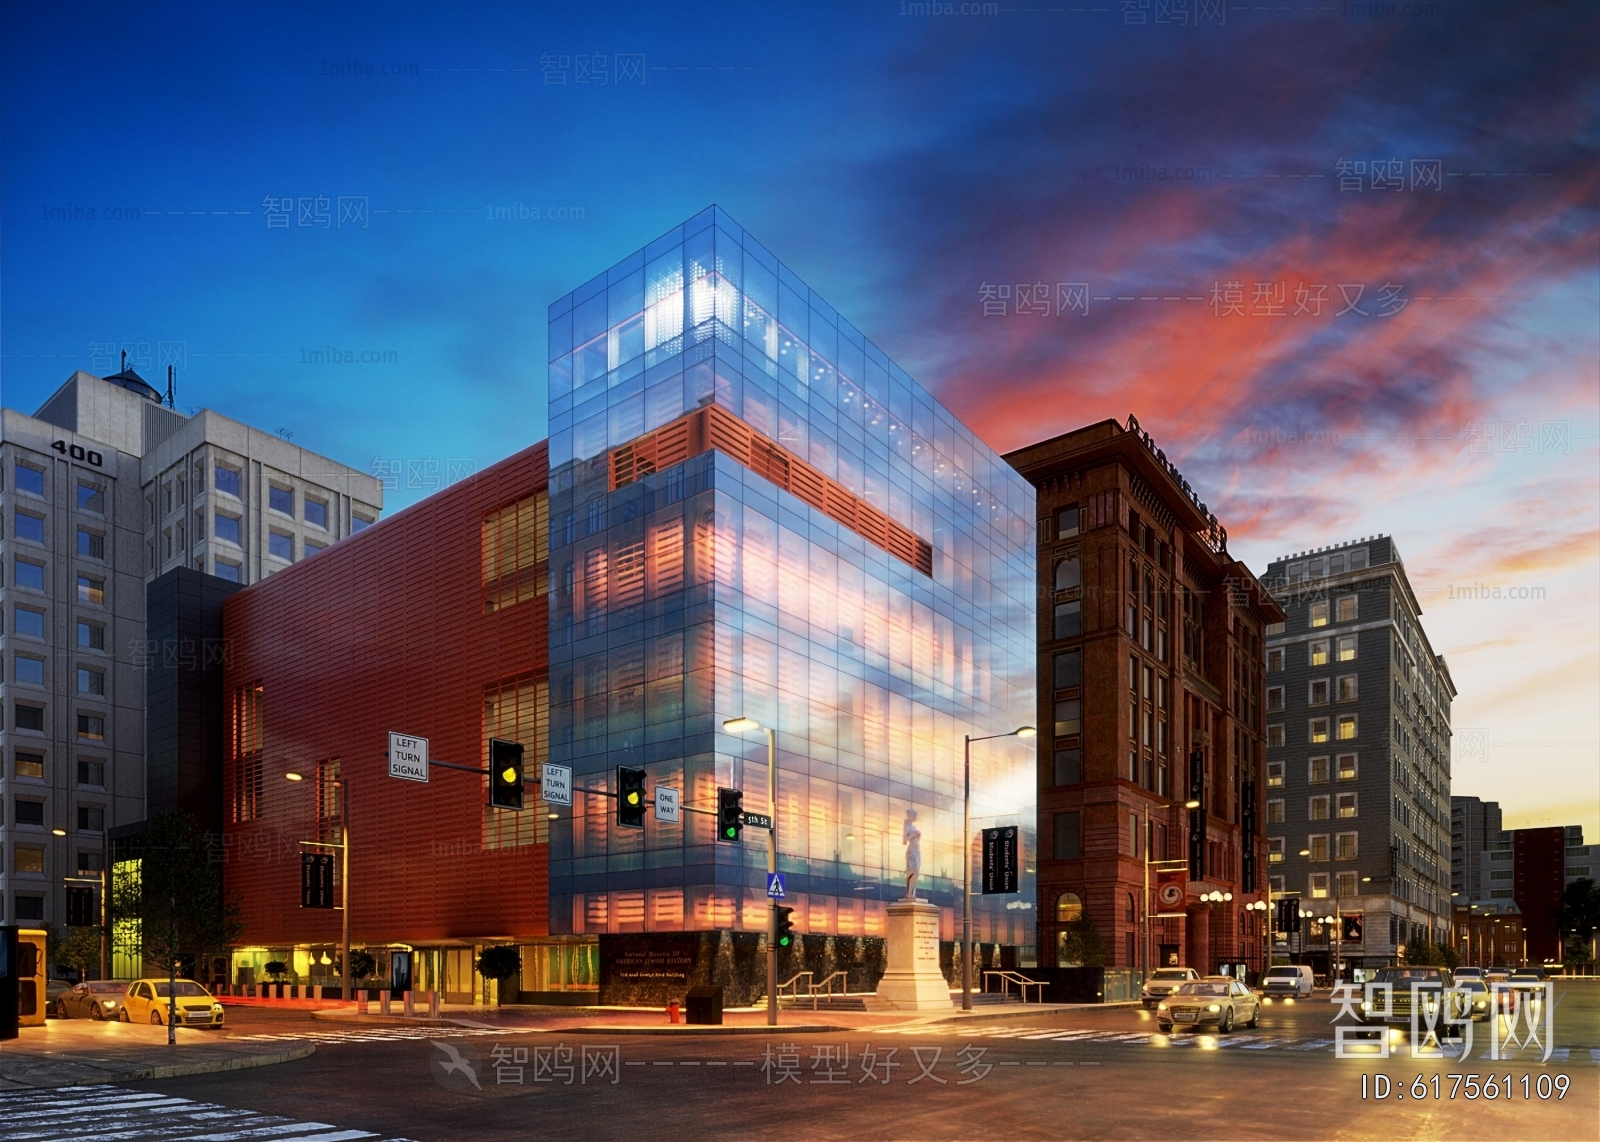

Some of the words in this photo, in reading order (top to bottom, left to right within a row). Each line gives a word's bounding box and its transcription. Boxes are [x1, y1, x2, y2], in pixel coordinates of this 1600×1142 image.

[50, 439, 103, 468] 400
[396, 737, 418, 749] LEFT
[395, 751, 421, 763] TURN
[391, 764, 426, 778] SIGNAL
[546, 767, 563, 778] LEFT
[545, 779, 565, 789] TURN
[543, 790, 569, 802] SIGNAL
[659, 793, 674, 803] ONE
[659, 805, 674, 815] WAY
[748, 815, 758, 824] 5th
[760, 817, 768, 826] St
[615, 957, 643, 965] AMERICAN
